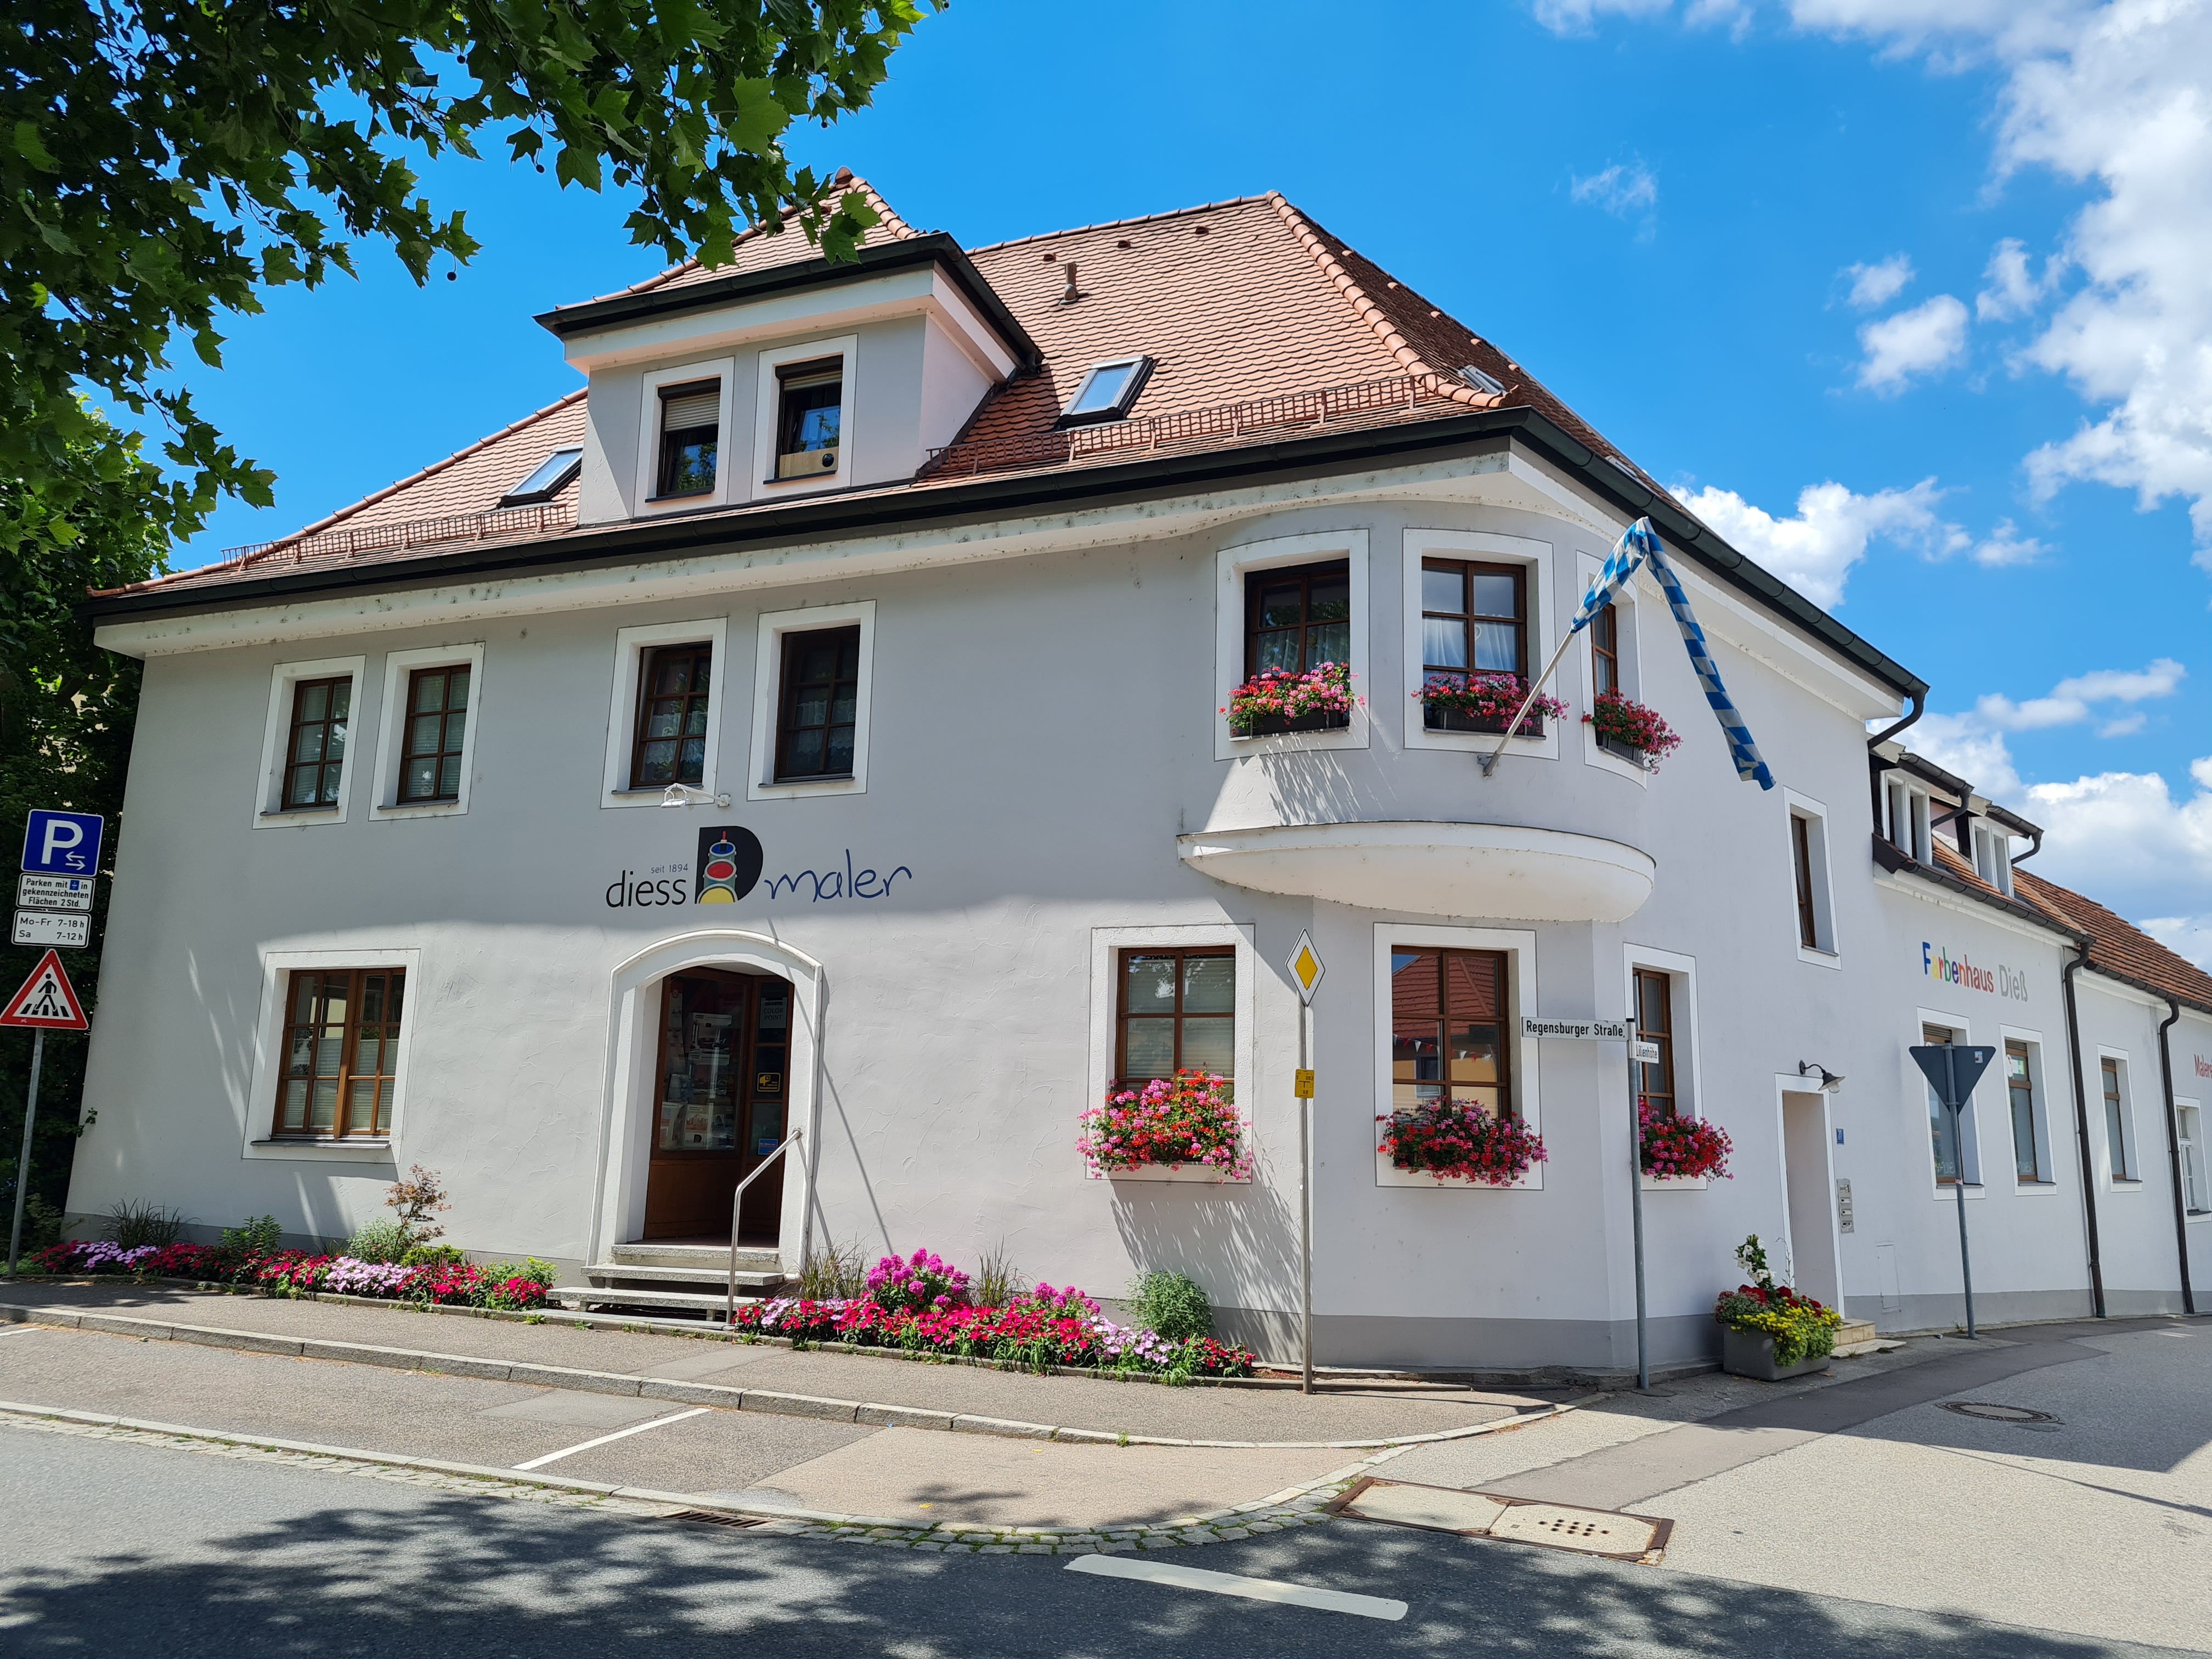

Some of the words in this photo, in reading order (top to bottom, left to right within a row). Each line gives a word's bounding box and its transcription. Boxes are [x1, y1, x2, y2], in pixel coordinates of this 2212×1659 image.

[41, 819, 83, 864] P
[651, 865, 665, 873] seit
[668, 864, 689, 873] 1894
[26, 878, 52, 887] Parken
[606, 870, 687, 907] diess
[764, 848, 912, 903] maler
[22, 888, 88, 899] gekennzeichneten
[28, 897, 57, 905] Flächen
[20, 917, 52, 926] Mo-Fr
[57, 932, 76, 940] 7-12
[1922, 941, 1994, 993] Farbenhaus
[1998, 964, 2028, 1002] Dieß
[1526, 1020, 1589, 1037] Regensburger
[1594, 1023, 1623, 1036] Straße
